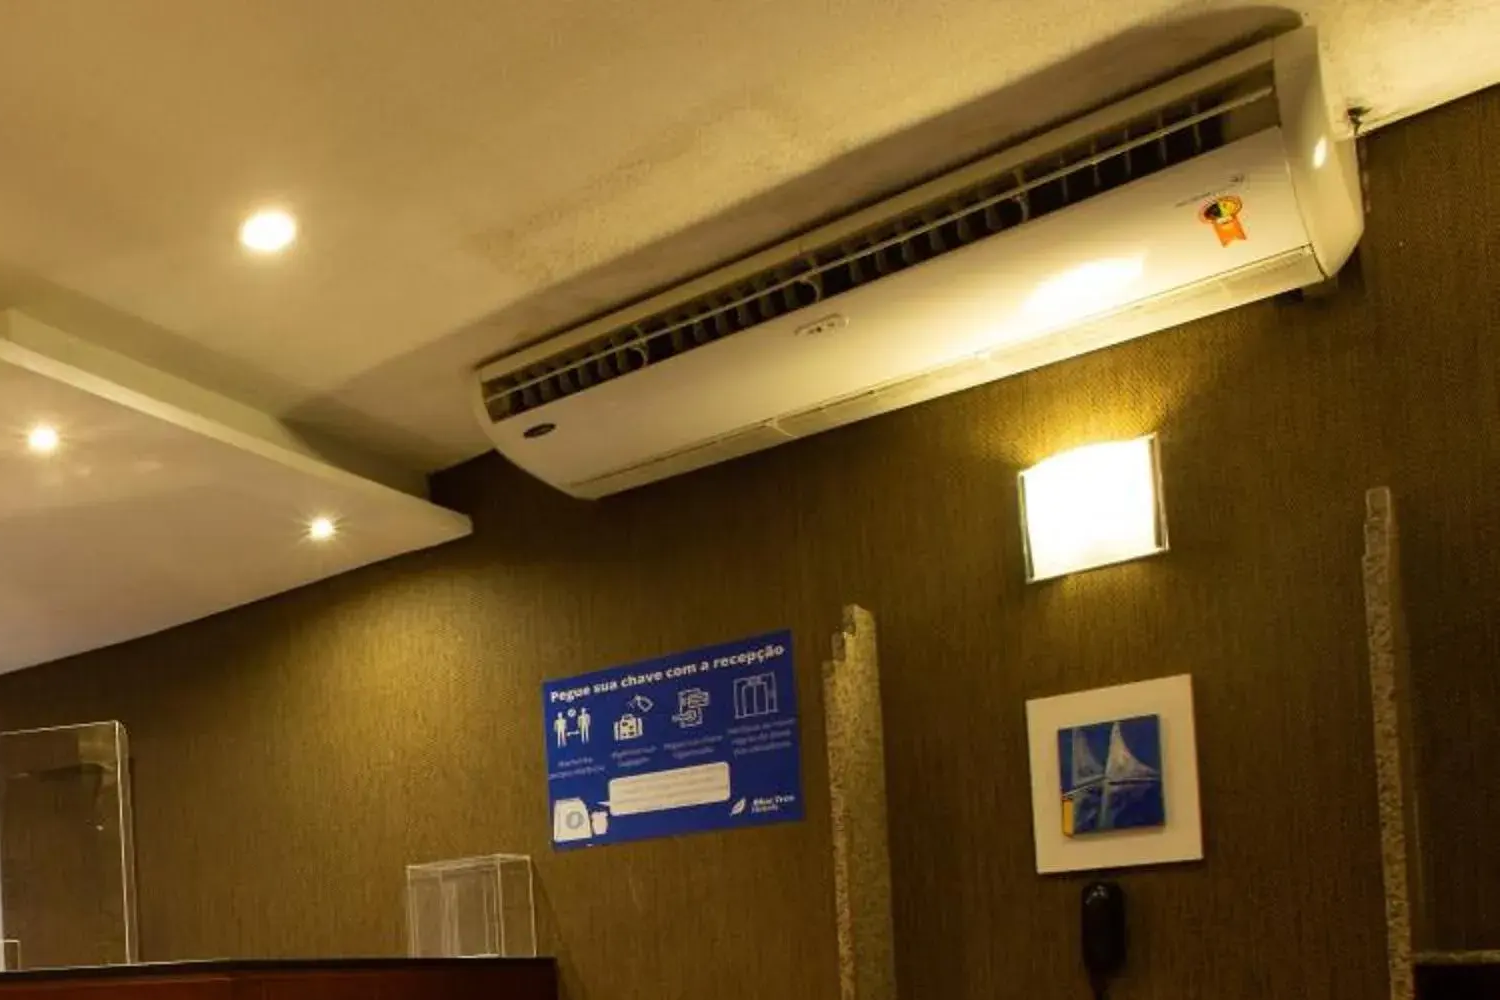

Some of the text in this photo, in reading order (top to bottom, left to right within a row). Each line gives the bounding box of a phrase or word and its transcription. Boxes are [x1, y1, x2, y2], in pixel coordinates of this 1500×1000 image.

[550, 643, 785, 704] Pegue sua chave com a recepção
